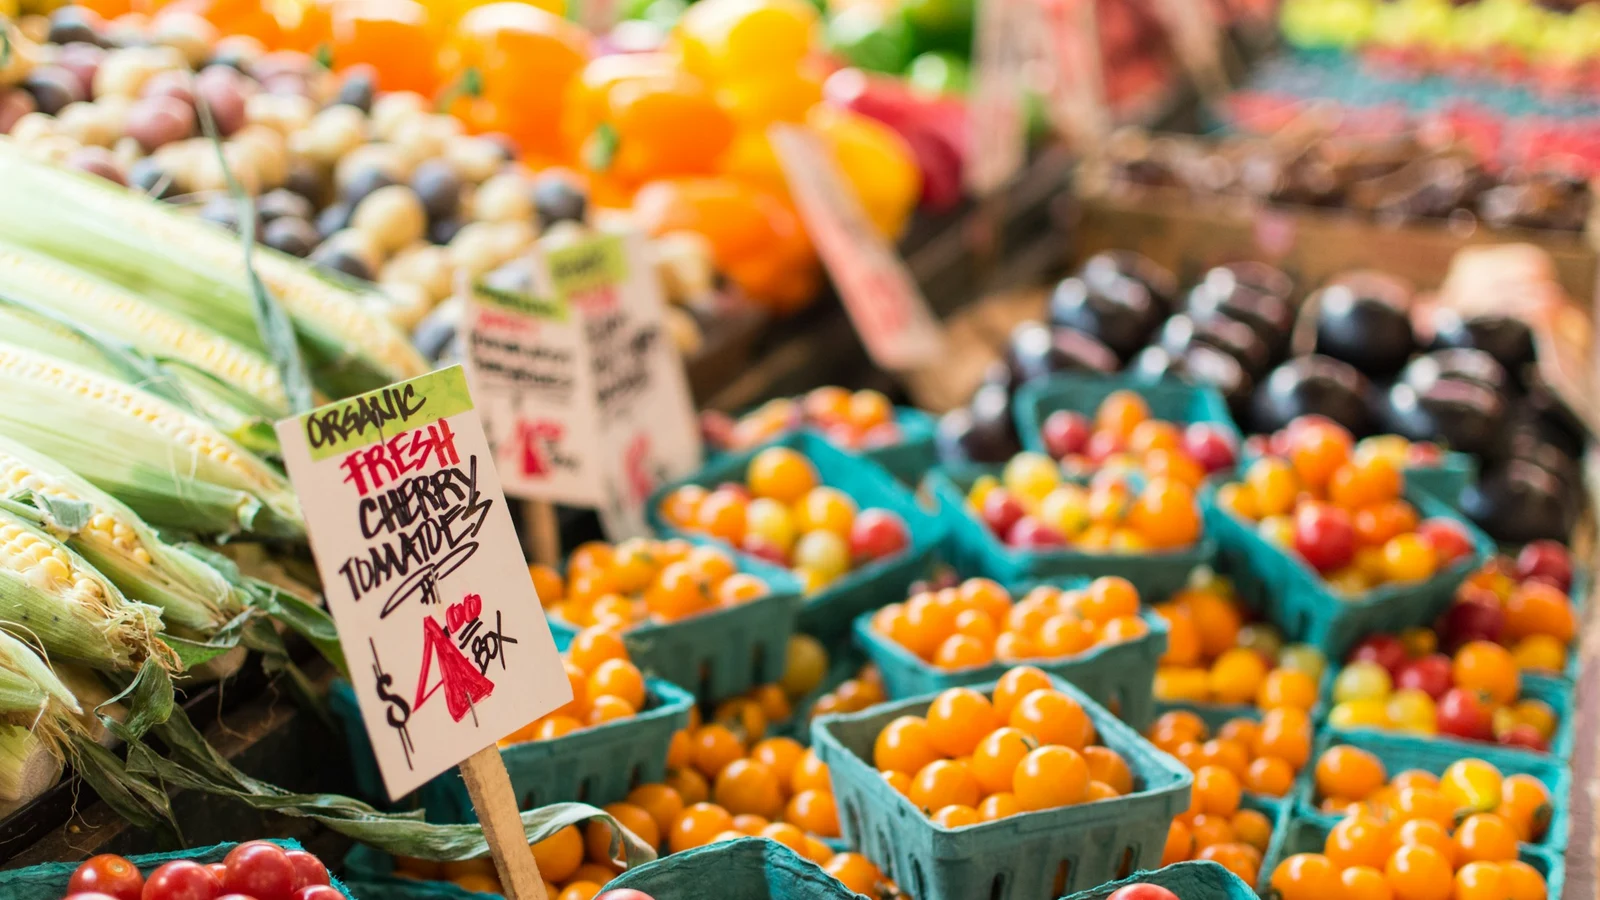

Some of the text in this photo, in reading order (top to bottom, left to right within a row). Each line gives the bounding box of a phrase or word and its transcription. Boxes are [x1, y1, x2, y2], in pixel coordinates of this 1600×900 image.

[306, 383, 427, 449] ORGANIC
[339, 418, 460, 497] FRESH
[359, 455, 477, 540] CHERRY
[339, 491, 493, 602] TOMATOES
[471, 610, 518, 676] BOX
